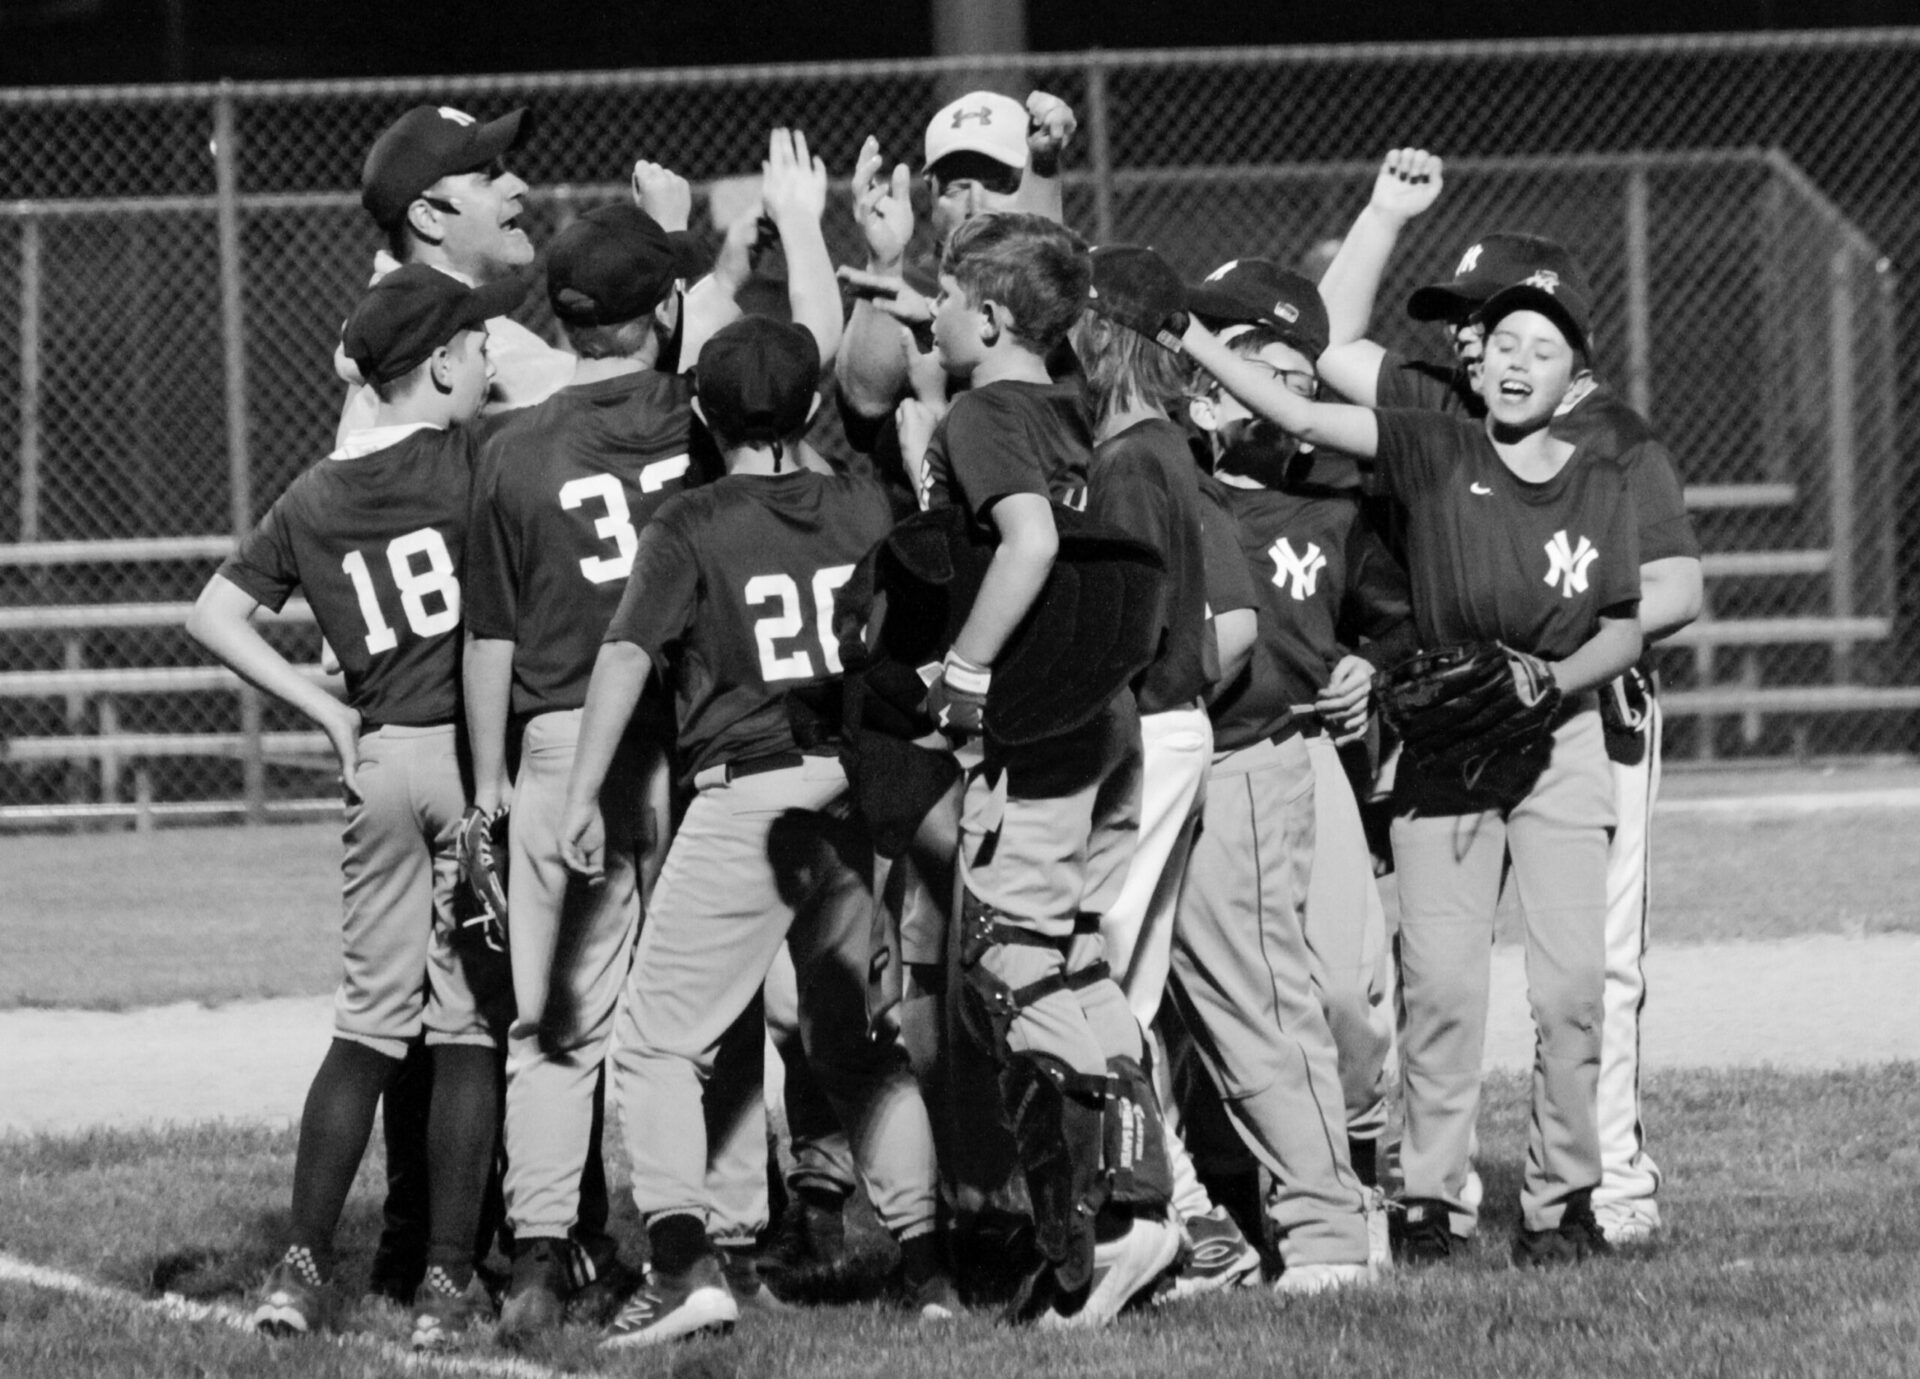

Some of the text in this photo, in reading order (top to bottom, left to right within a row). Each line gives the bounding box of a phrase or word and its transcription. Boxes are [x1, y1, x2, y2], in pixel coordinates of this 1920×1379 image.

[341, 527, 460, 655] 18
[1267, 537, 1327, 601] NY
[1543, 529, 1599, 598] NY
